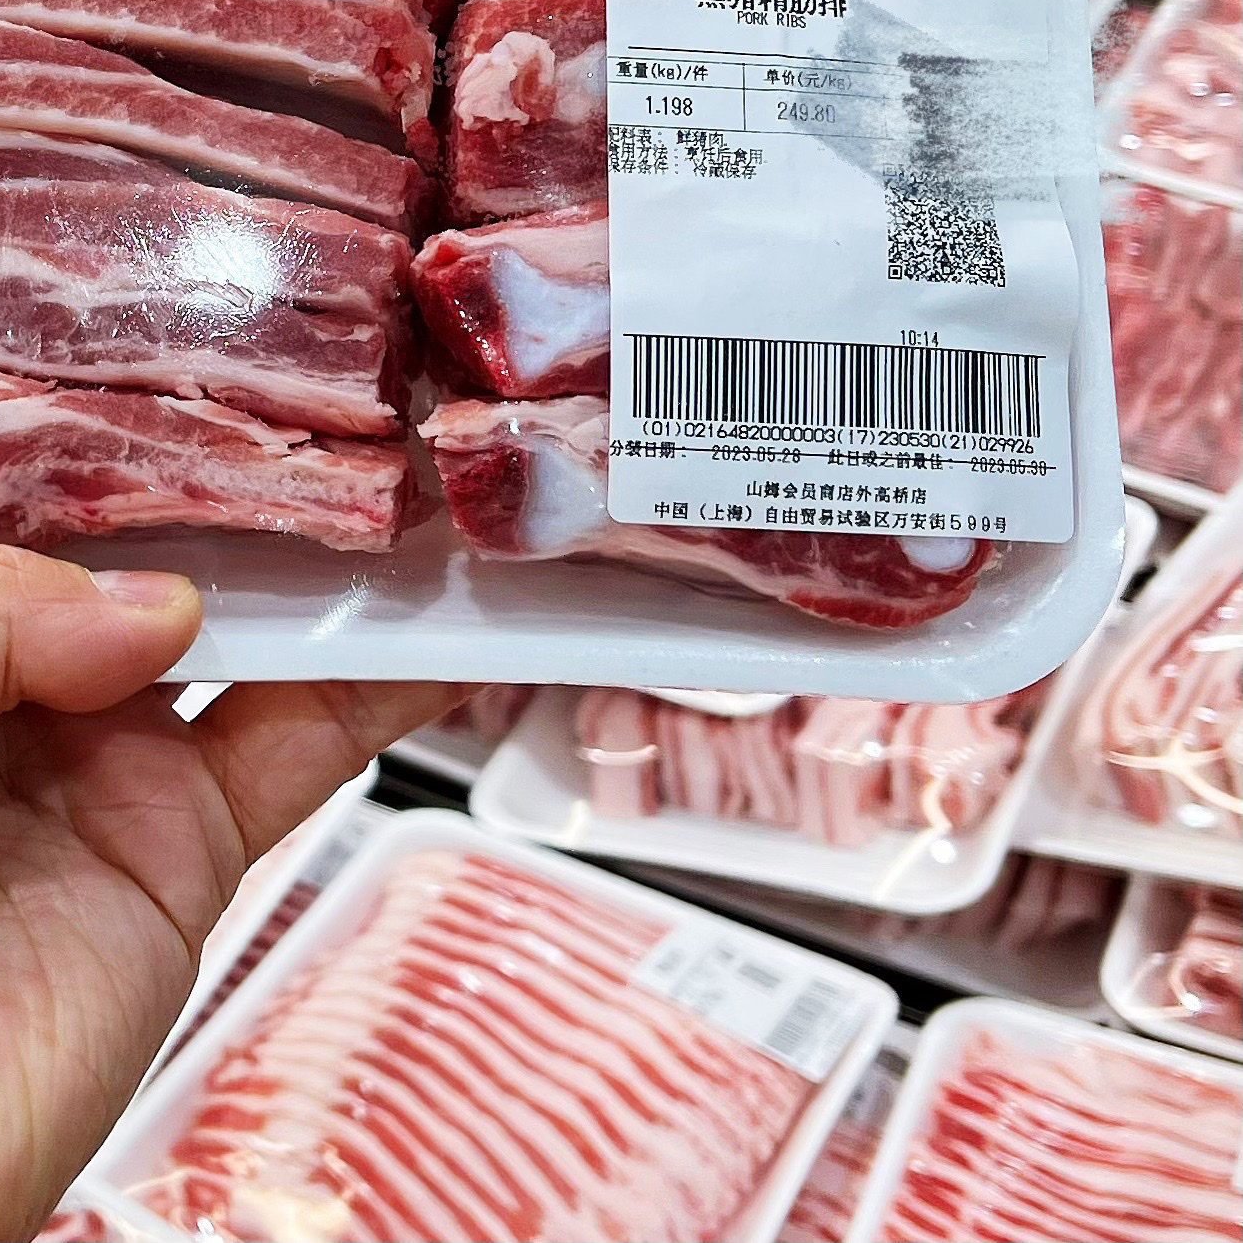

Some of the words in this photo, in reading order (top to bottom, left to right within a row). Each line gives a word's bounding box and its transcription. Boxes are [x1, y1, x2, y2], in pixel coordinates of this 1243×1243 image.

[737, 11, 768, 25] PORK
[776, 13, 807, 28] RIBS
[616, 61, 708, 82] 重量(kg)/件
[645, 95, 694, 116] 1.198
[776, 101, 836, 124] 249.80
[900, 329, 939, 347] 10:14
[643, 421, 1034, 455] (01)02164820000003(17)230530(21)029926
[746, 481, 927, 505] 山姆会员商店外高桥店
